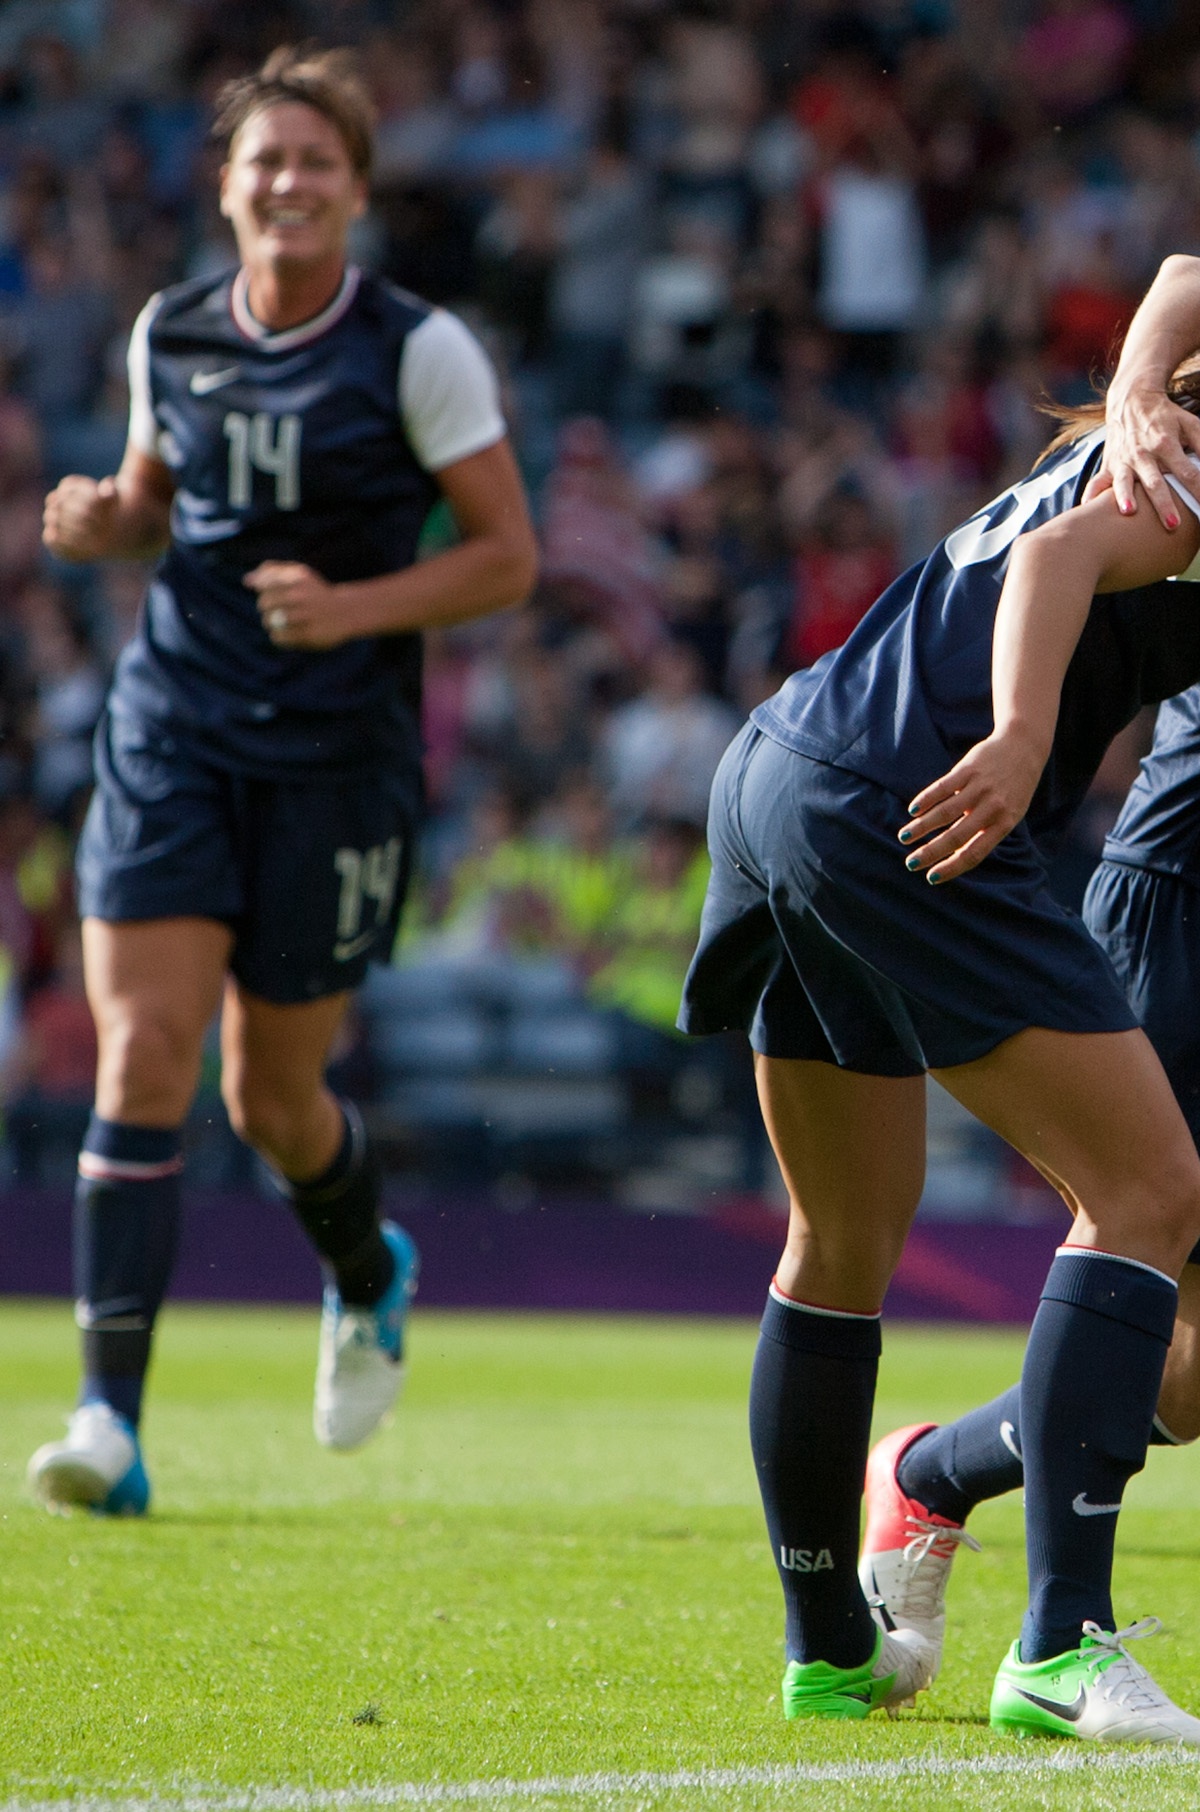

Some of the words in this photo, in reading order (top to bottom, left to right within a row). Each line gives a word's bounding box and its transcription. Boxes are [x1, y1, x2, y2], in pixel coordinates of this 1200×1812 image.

[223, 411, 302, 512] 14
[334, 838, 402, 939] 14
[780, 1545, 835, 1573] USA
